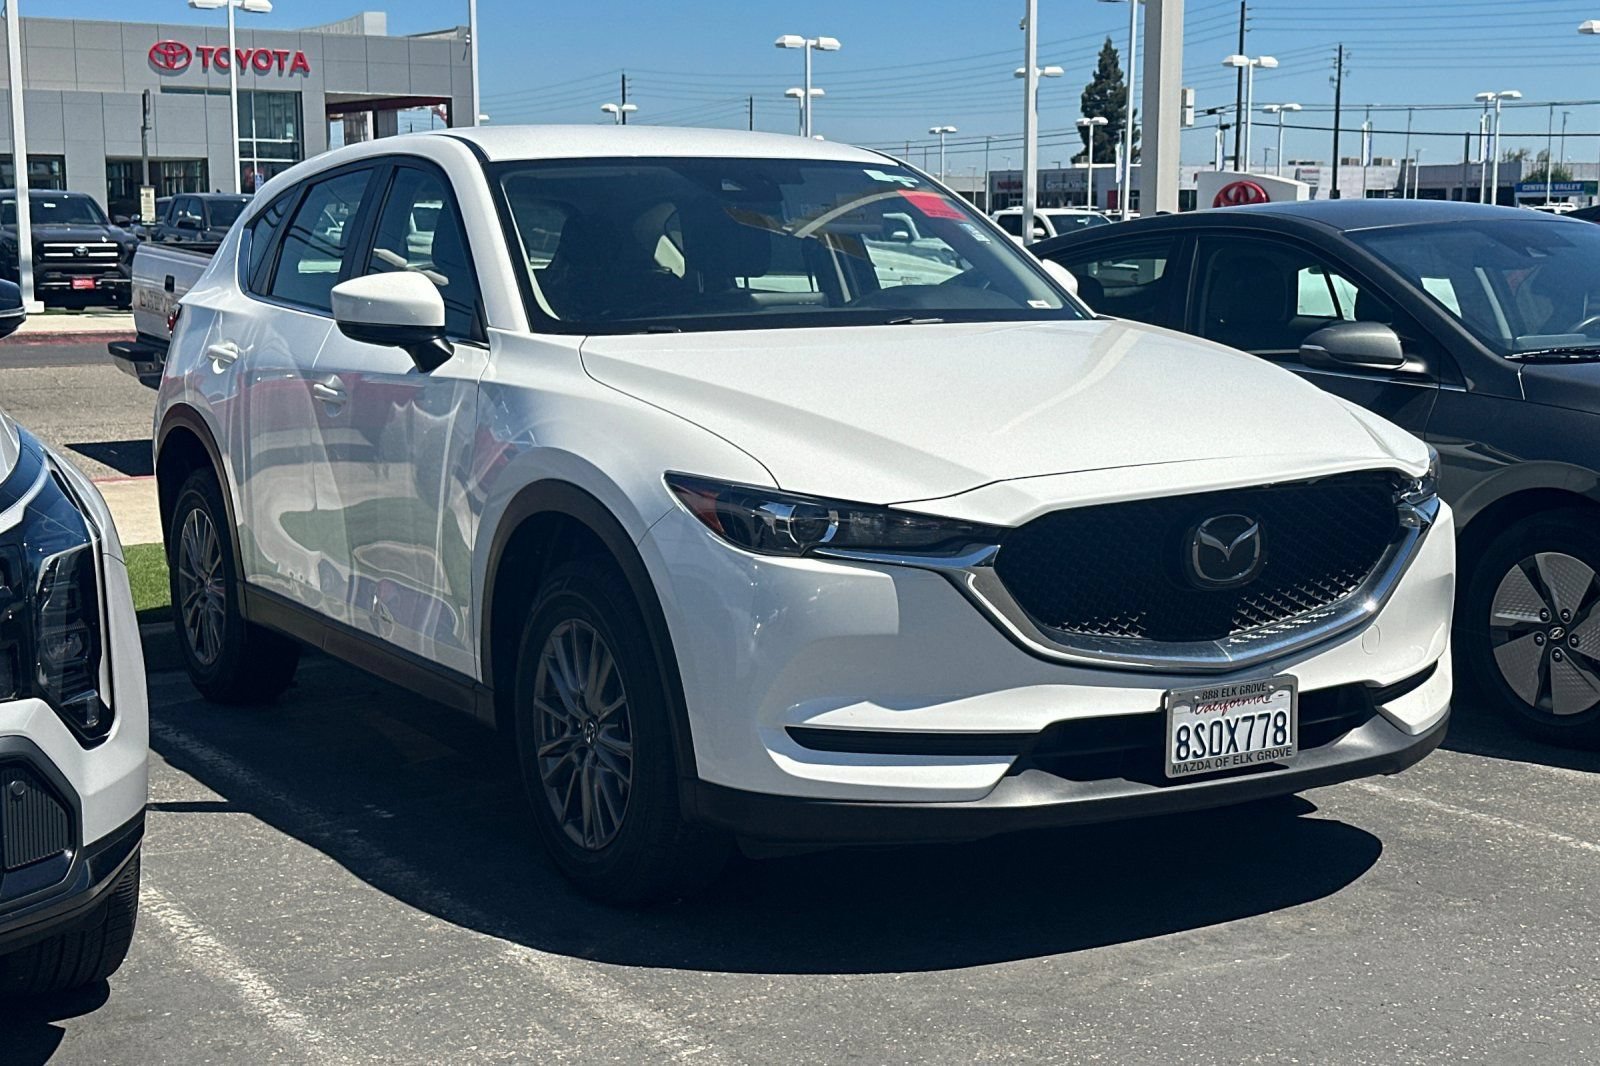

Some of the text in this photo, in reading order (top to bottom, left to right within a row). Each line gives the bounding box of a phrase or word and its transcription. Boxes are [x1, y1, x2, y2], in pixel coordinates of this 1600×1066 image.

[196, 46, 310, 72] TOYOTA
[1221, 686, 1237, 698] ELK
[1240, 682, 1267, 695] GROVE
[1194, 694, 1272, 716] California
[1176, 711, 1287, 761] 8SOX778
[1172, 747, 1292, 775] MAZDA OF ELK GROVE
